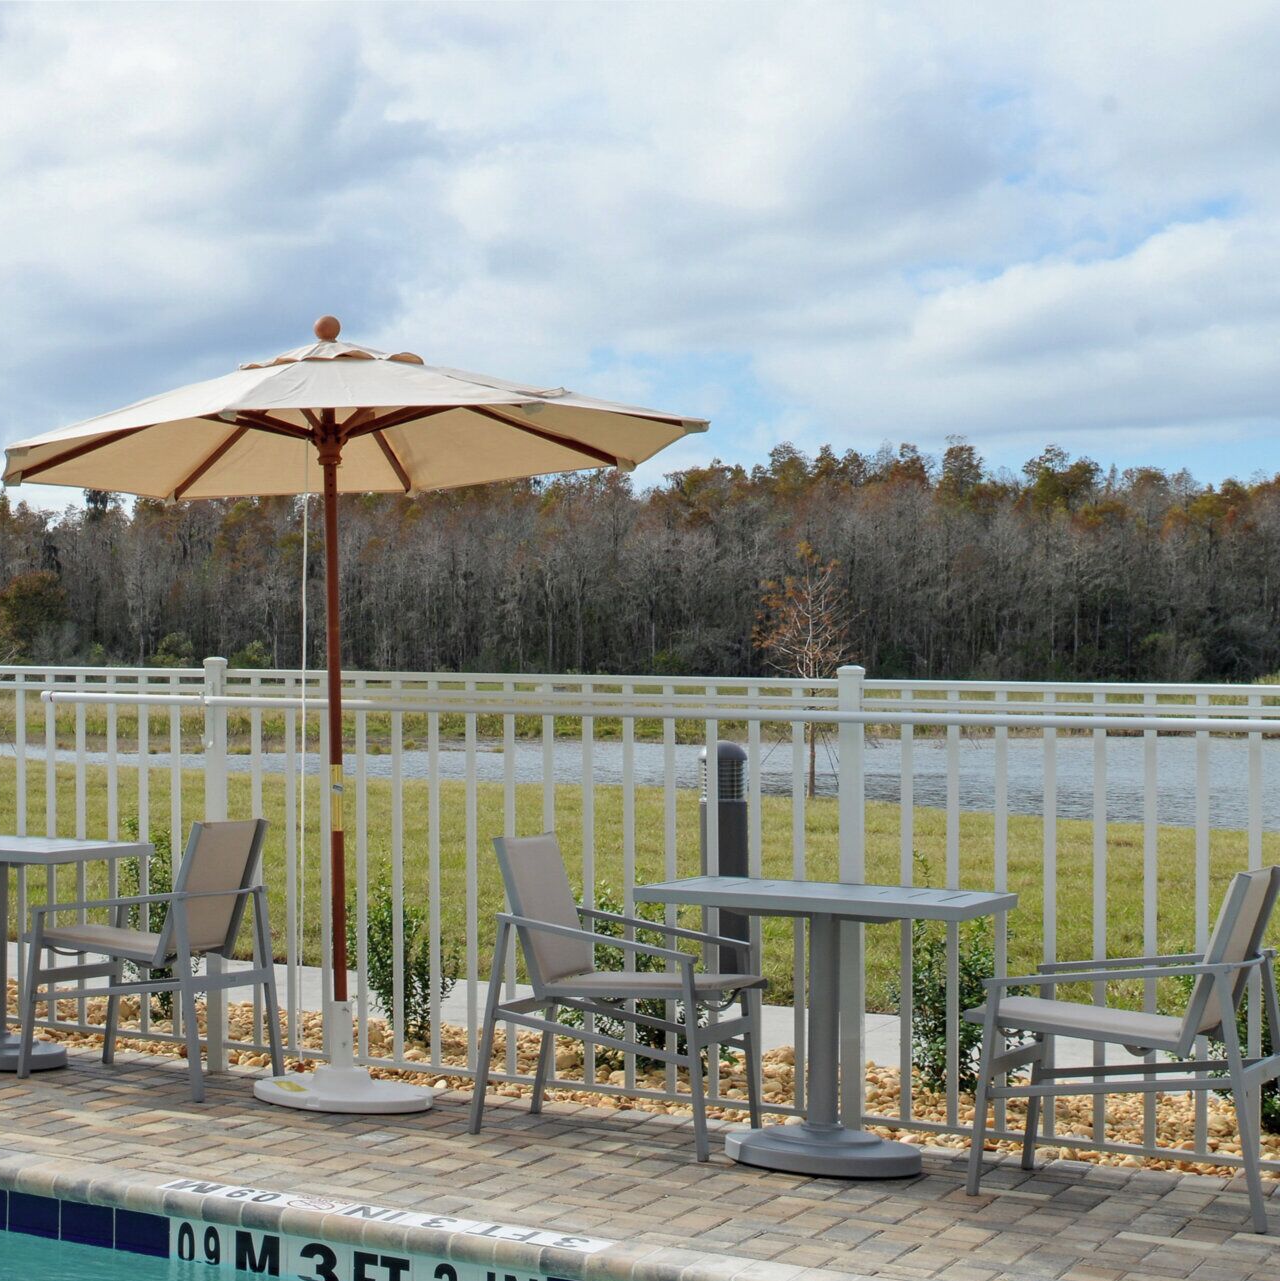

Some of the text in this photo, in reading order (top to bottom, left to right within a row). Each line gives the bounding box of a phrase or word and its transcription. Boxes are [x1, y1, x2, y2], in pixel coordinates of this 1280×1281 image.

[167, 1180, 224, 1194] M
[343, 1205, 407, 1222] IN
[235, 1230, 280, 1277] M
